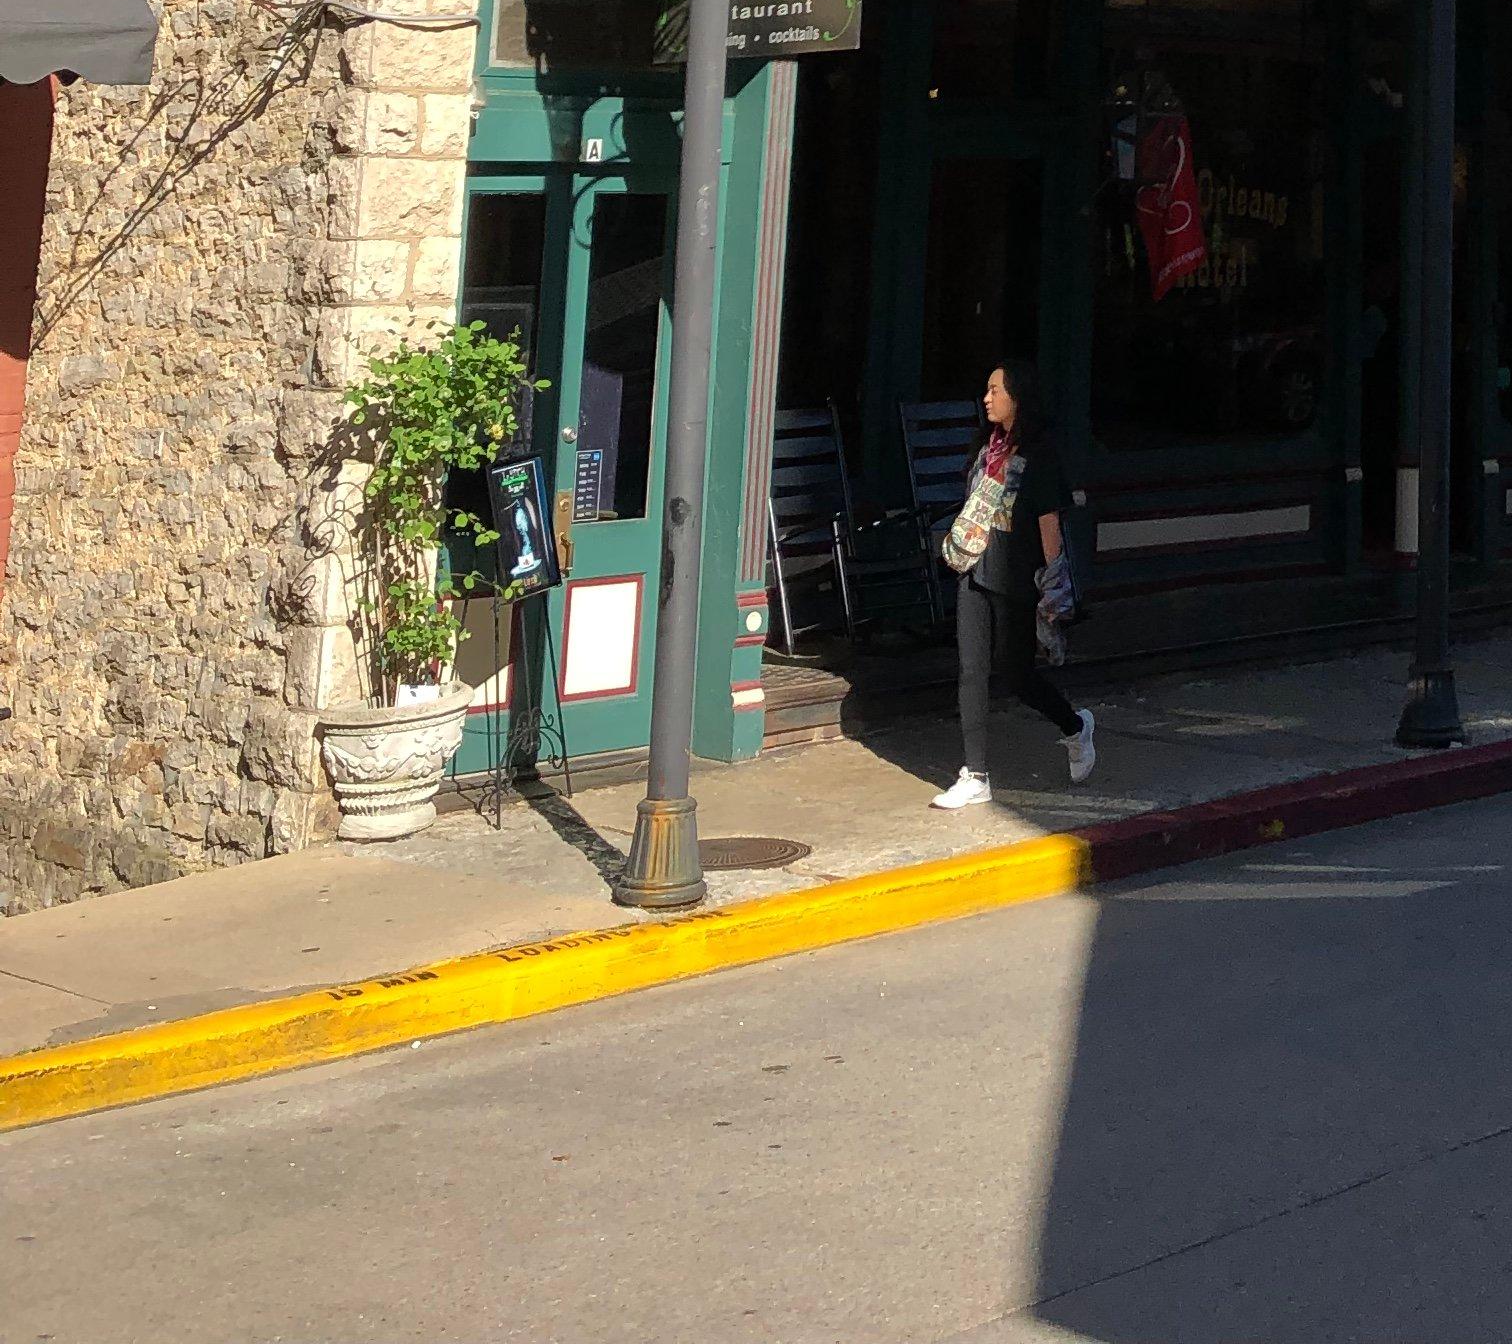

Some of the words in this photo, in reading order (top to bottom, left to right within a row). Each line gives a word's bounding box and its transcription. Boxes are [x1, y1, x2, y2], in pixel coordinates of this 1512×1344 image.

[768, 25, 820, 44] cocktails
[588, 141, 600, 160] A
[377, 971, 440, 989] MIN
[497, 929, 632, 963] LOADING
